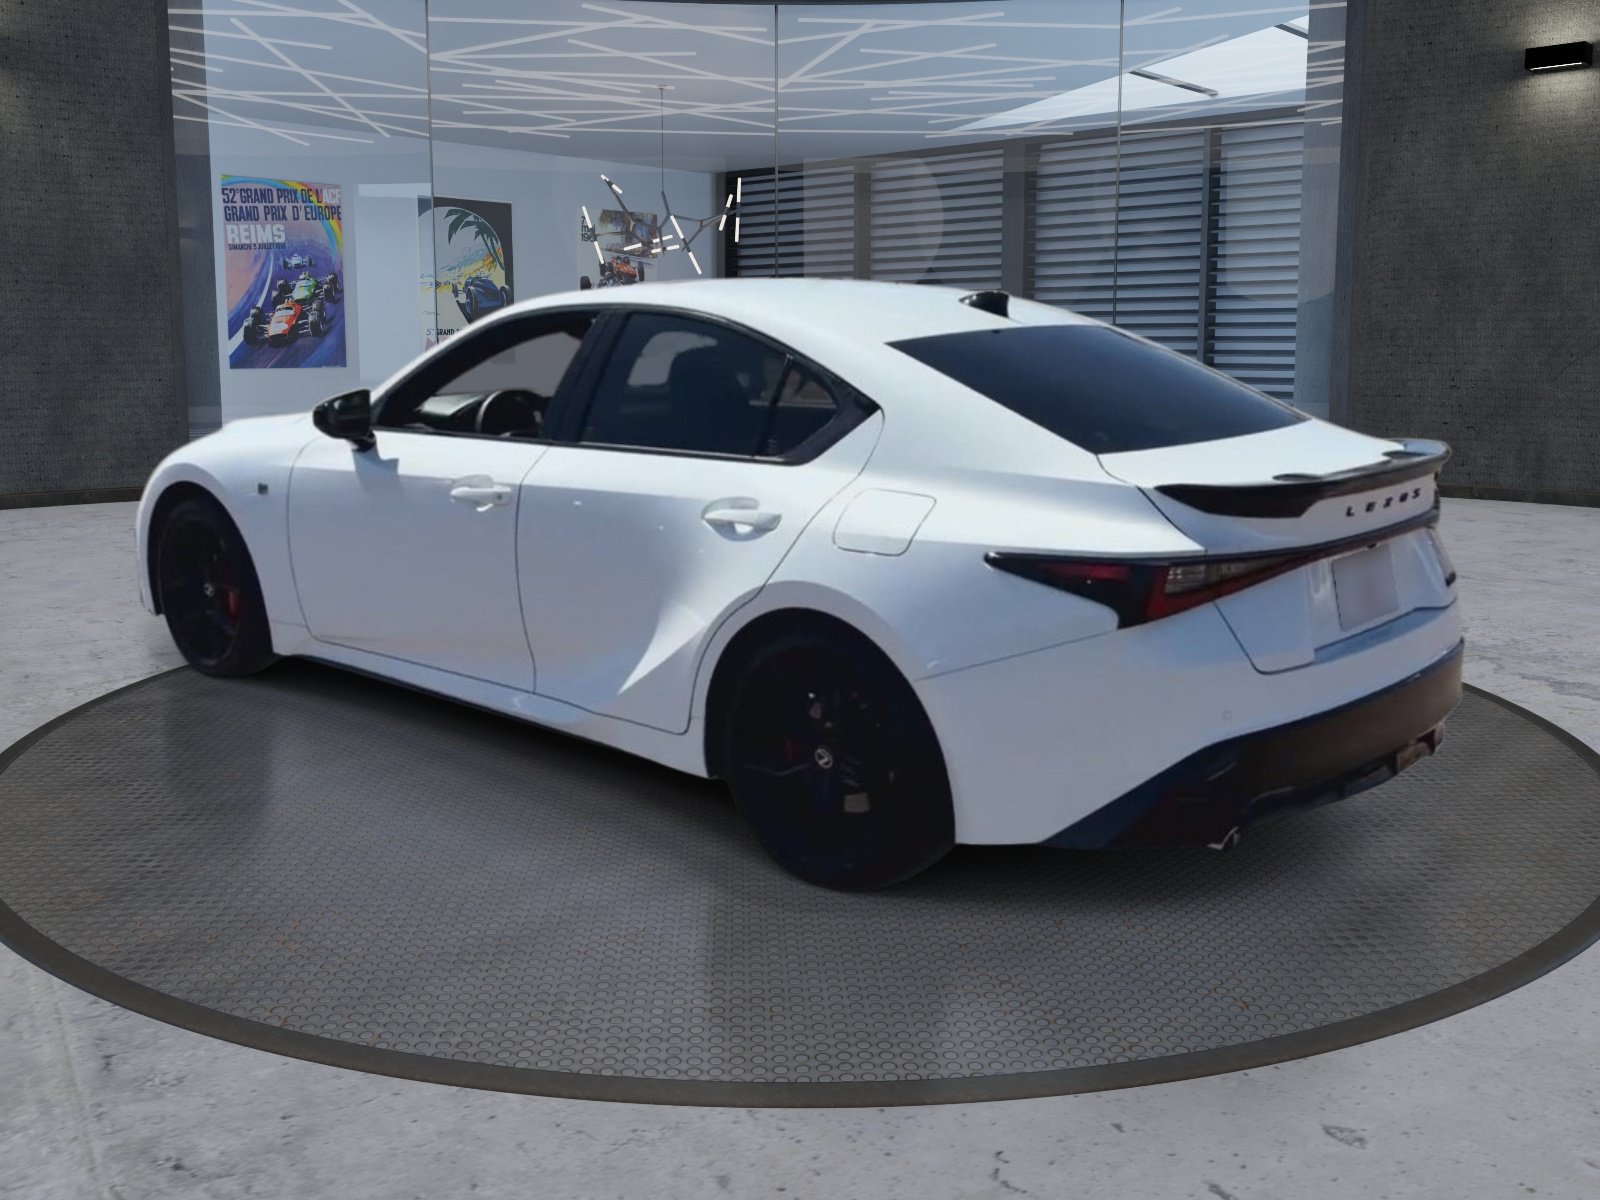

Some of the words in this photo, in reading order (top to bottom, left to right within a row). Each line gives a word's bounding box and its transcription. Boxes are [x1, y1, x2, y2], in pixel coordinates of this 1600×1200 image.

[240, 188, 274, 204] GRAND
[276, 188, 298, 204] PRIX
[300, 188, 312, 204] DE
[224, 205, 259, 221] GRAND
[264, 205, 288, 221] PRIX
[225, 224, 286, 244] REIMS
